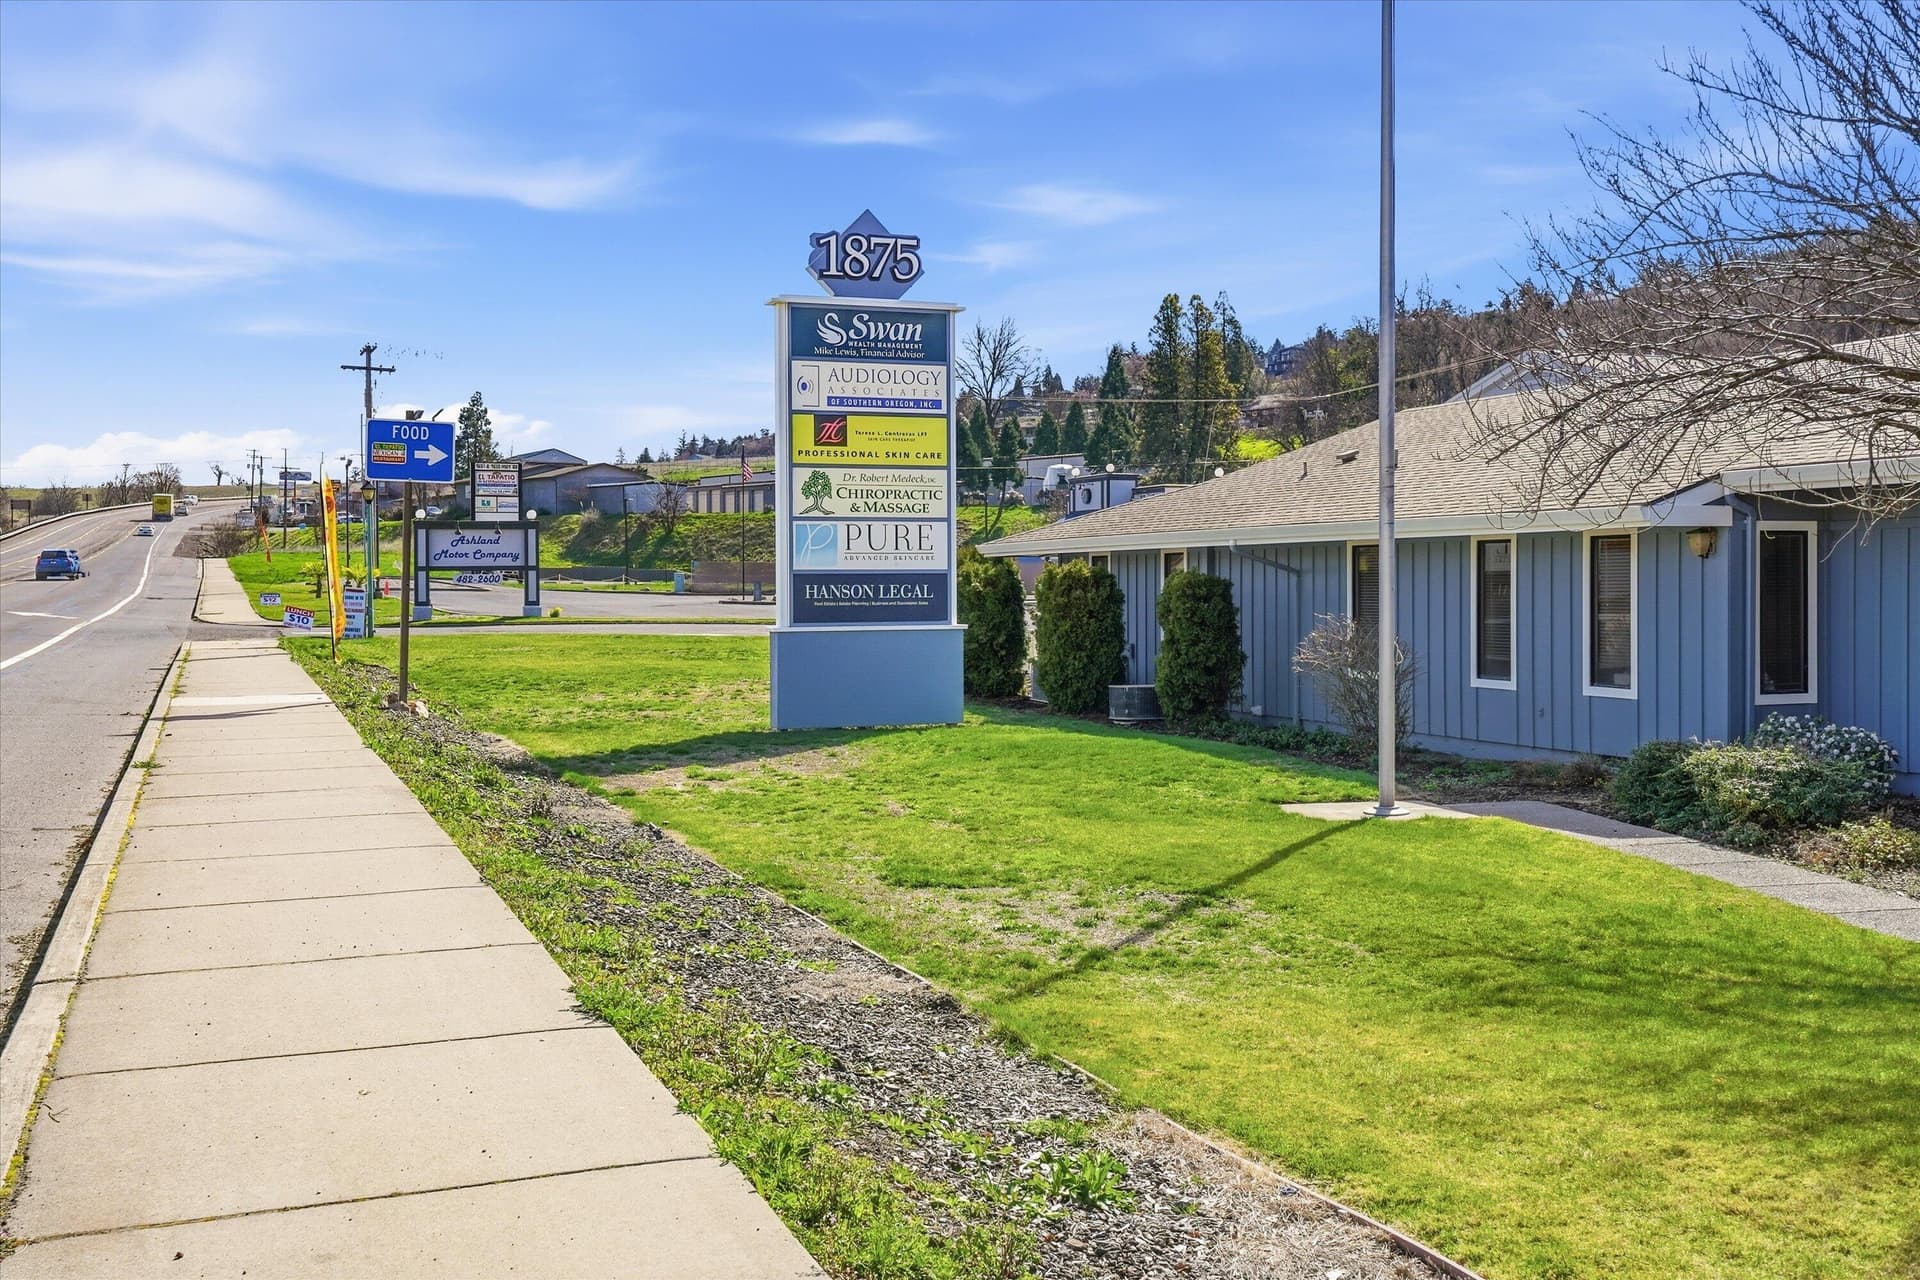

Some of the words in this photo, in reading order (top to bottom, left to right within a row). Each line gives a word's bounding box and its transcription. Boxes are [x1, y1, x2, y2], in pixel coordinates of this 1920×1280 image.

[818, 233, 920, 281] 1875
[849, 313, 923, 342] Swan
[814, 346, 833, 355] Mike
[835, 347, 859, 357] Lewis,
[860, 348, 895, 358] Financial
[896, 350, 925, 358] Advisor
[828, 367, 942, 386] AUDIOLOGY
[828, 386, 940, 397] ASSOCIATES
[843, 399, 882, 407] SOUTHERN
[884, 400, 917, 408] OREGON,
[920, 400, 936, 408] INC.
[392, 425, 430, 440] FOOD
[798, 449, 880, 458] PROFESSIONAL
[885, 451, 910, 459] SKIN
[842, 473, 857, 482] Dr.
[860, 473, 889, 483] Robert
[836, 486, 943, 500] CHIROPRACTIC
[850, 502, 861, 513] &
[863, 501, 930, 514] MASSAGE
[450, 536, 501, 548] Ashland
[844, 523, 934, 551] PURE
[433, 550, 469, 561] Motor
[473, 549, 520, 562] Company
[805, 584, 874, 599] HANSON
[879, 584, 934, 599] LEGAL
[286, 606, 314, 617] LUNCH
